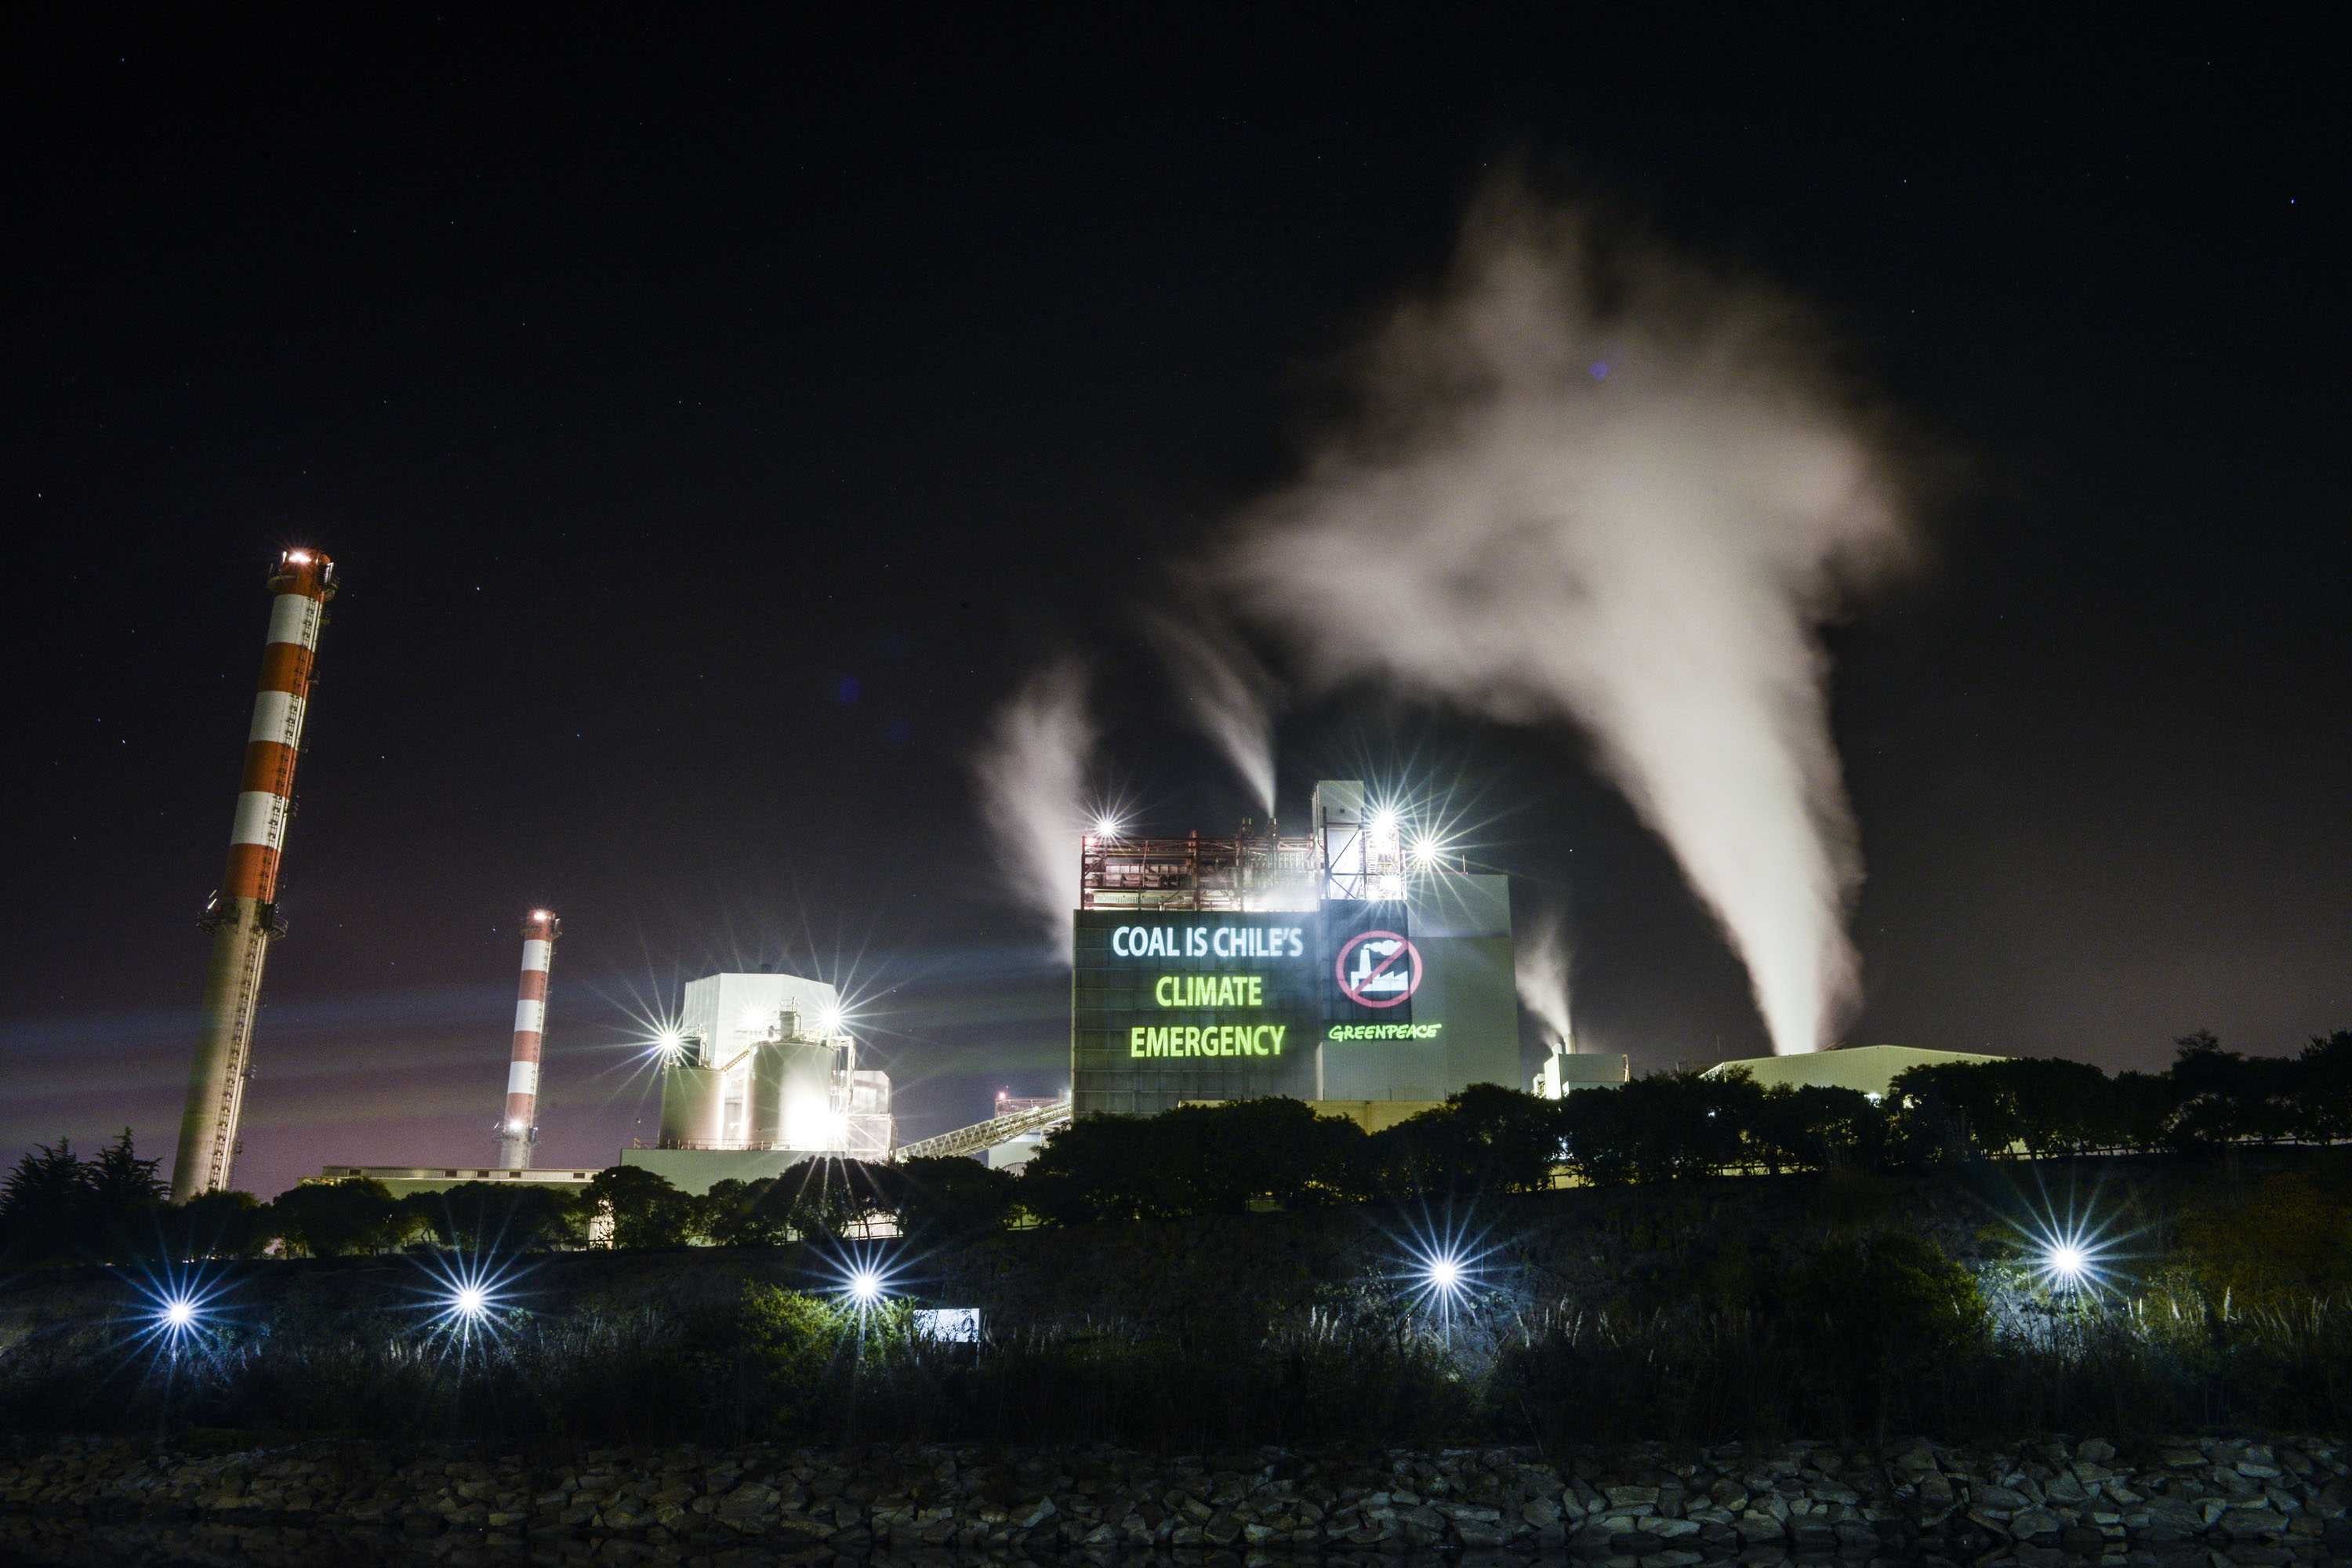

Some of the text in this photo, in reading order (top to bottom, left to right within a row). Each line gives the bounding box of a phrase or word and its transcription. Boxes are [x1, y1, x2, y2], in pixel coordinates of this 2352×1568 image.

[1112, 926, 1303, 956] COAL IS CHILE'S
[1156, 976, 1262, 1007] CLIMATE
[1131, 1025, 1286, 1058] EMERGENCY
[1329, 1023, 1443, 1041] GREENPEACE
